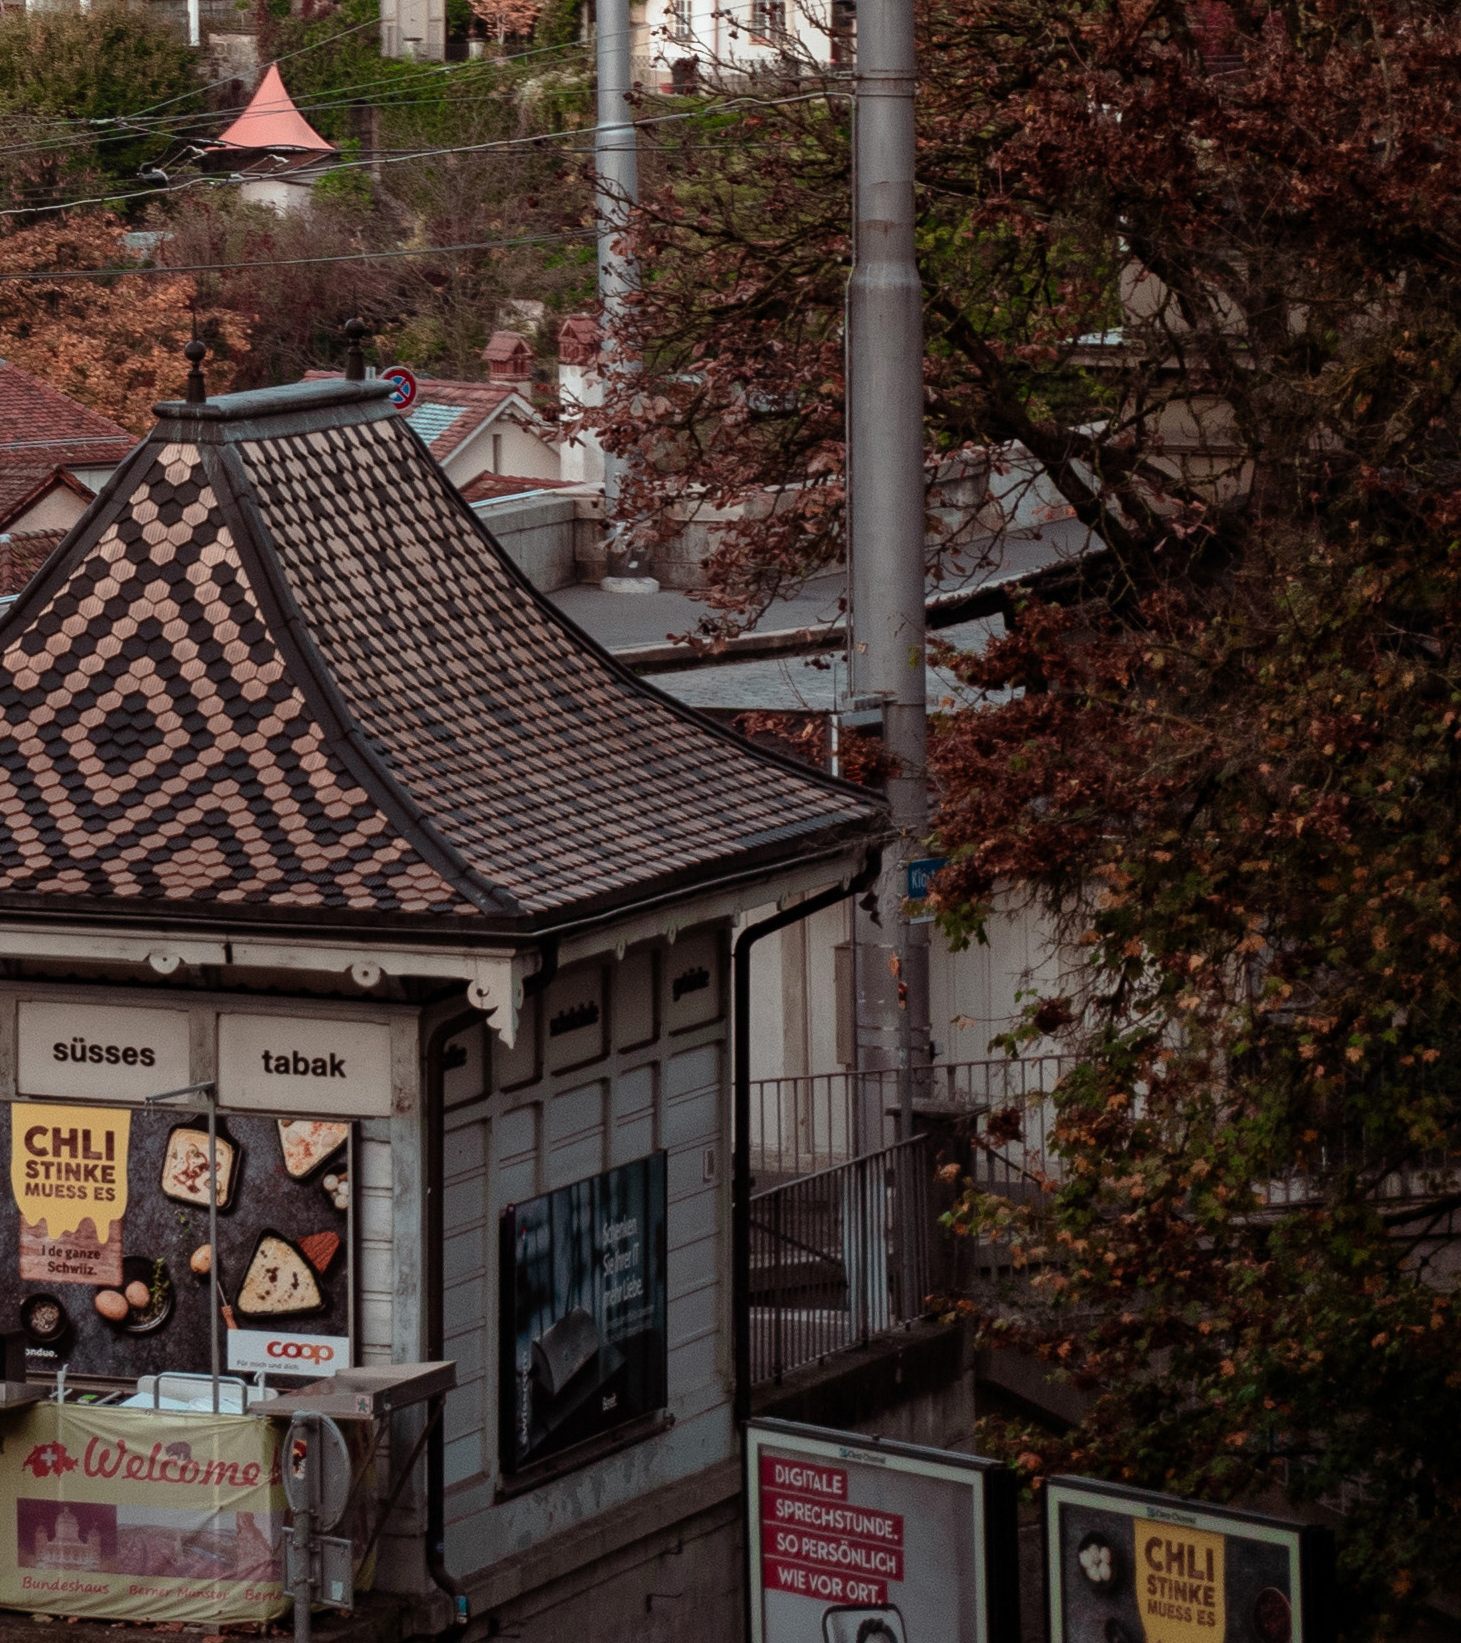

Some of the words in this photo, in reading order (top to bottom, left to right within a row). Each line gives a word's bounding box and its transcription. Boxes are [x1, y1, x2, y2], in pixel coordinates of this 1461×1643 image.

[52, 1036, 156, 1067] süsses
[261, 1049, 347, 1078] tabak
[24, 1125, 115, 1161] CHLI
[25, 1159, 116, 1184] STINKE
[24, 1182, 88, 1200] MUESS
[94, 1187, 116, 1202] ES
[48, 1245, 63, 1257] de
[65, 1249, 101, 1260] ganze
[47, 1261, 98, 1276] Schwiiz.
[266, 1340, 335, 1365] coop
[83, 1436, 261, 1487] Welcome
[775, 1464, 843, 1495] DIGITALE
[776, 1498, 899, 1540] SPRECHSTUNDE.
[776, 1532, 799, 1553] SO
[802, 1537, 897, 1574] PERSÖNLICH
[1145, 1536, 1214, 1582] CHLI
[21, 1575, 111, 1595] Bundeshaus
[777, 1566, 806, 1589] WIE
[809, 1573, 843, 1597] VOR
[846, 1580, 883, 1604] ORT.
[1146, 1573, 1216, 1608] STINKE
[1147, 1598, 1193, 1623] MUESS
[1197, 1609, 1216, 1628] ES
